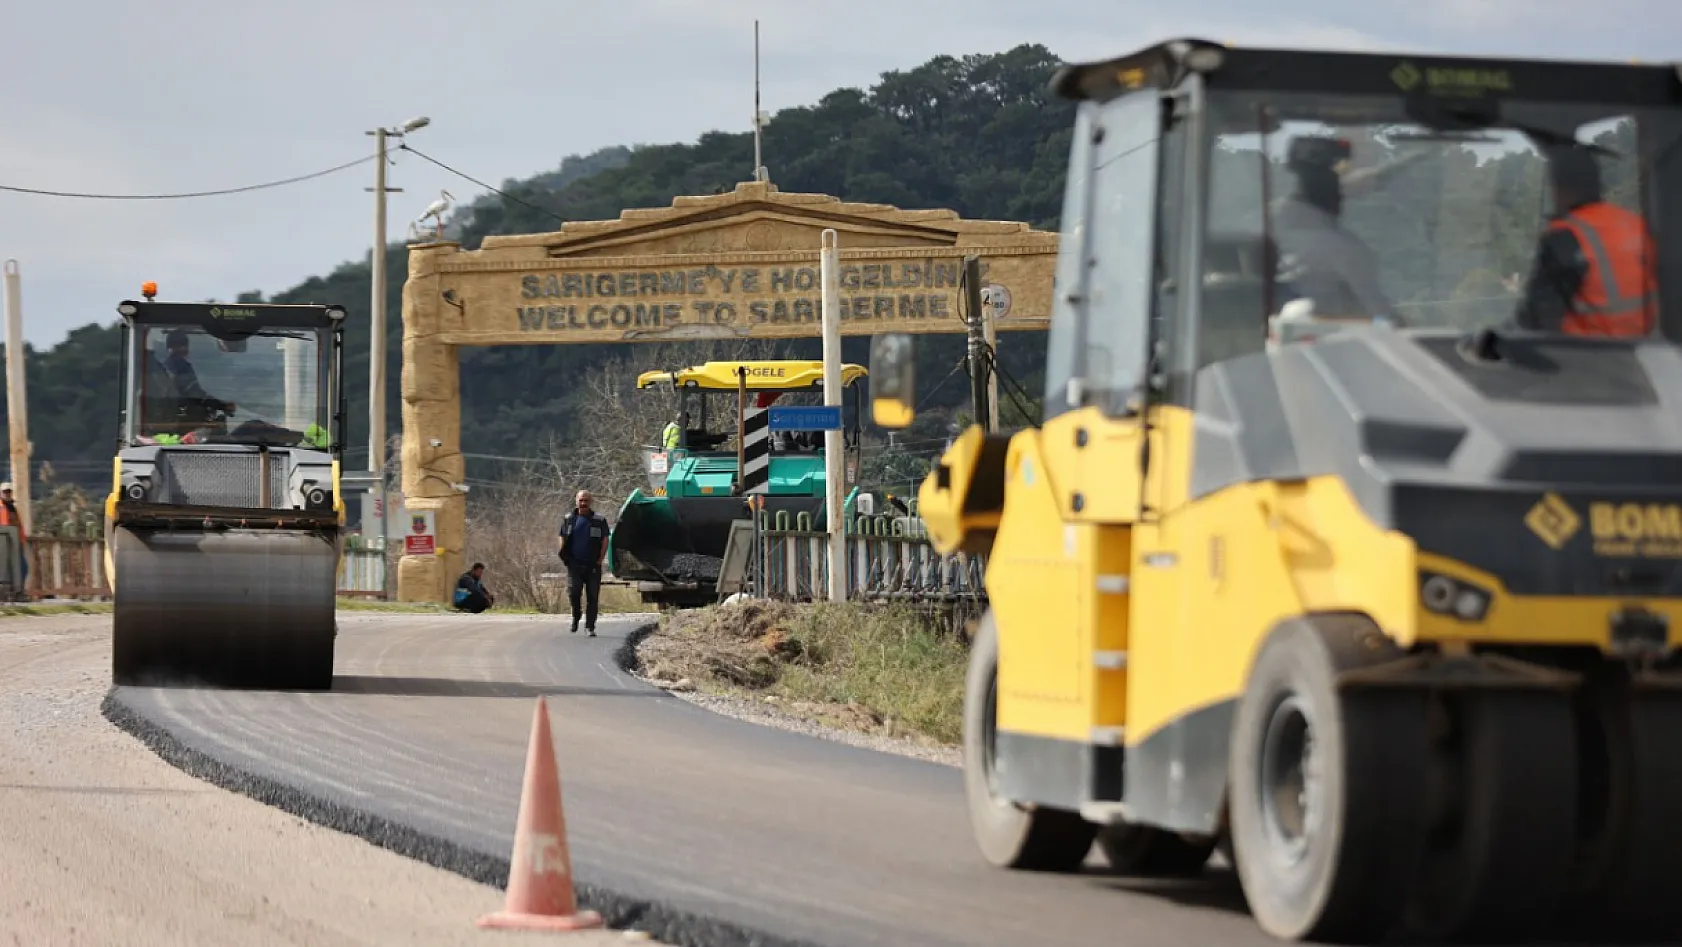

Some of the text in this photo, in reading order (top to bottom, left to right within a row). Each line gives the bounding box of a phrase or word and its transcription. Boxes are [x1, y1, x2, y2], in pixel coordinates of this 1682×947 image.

[516, 303, 682, 331] WELCOME
[693, 301, 738, 325] TO
[1589, 501, 1682, 539] BOM
